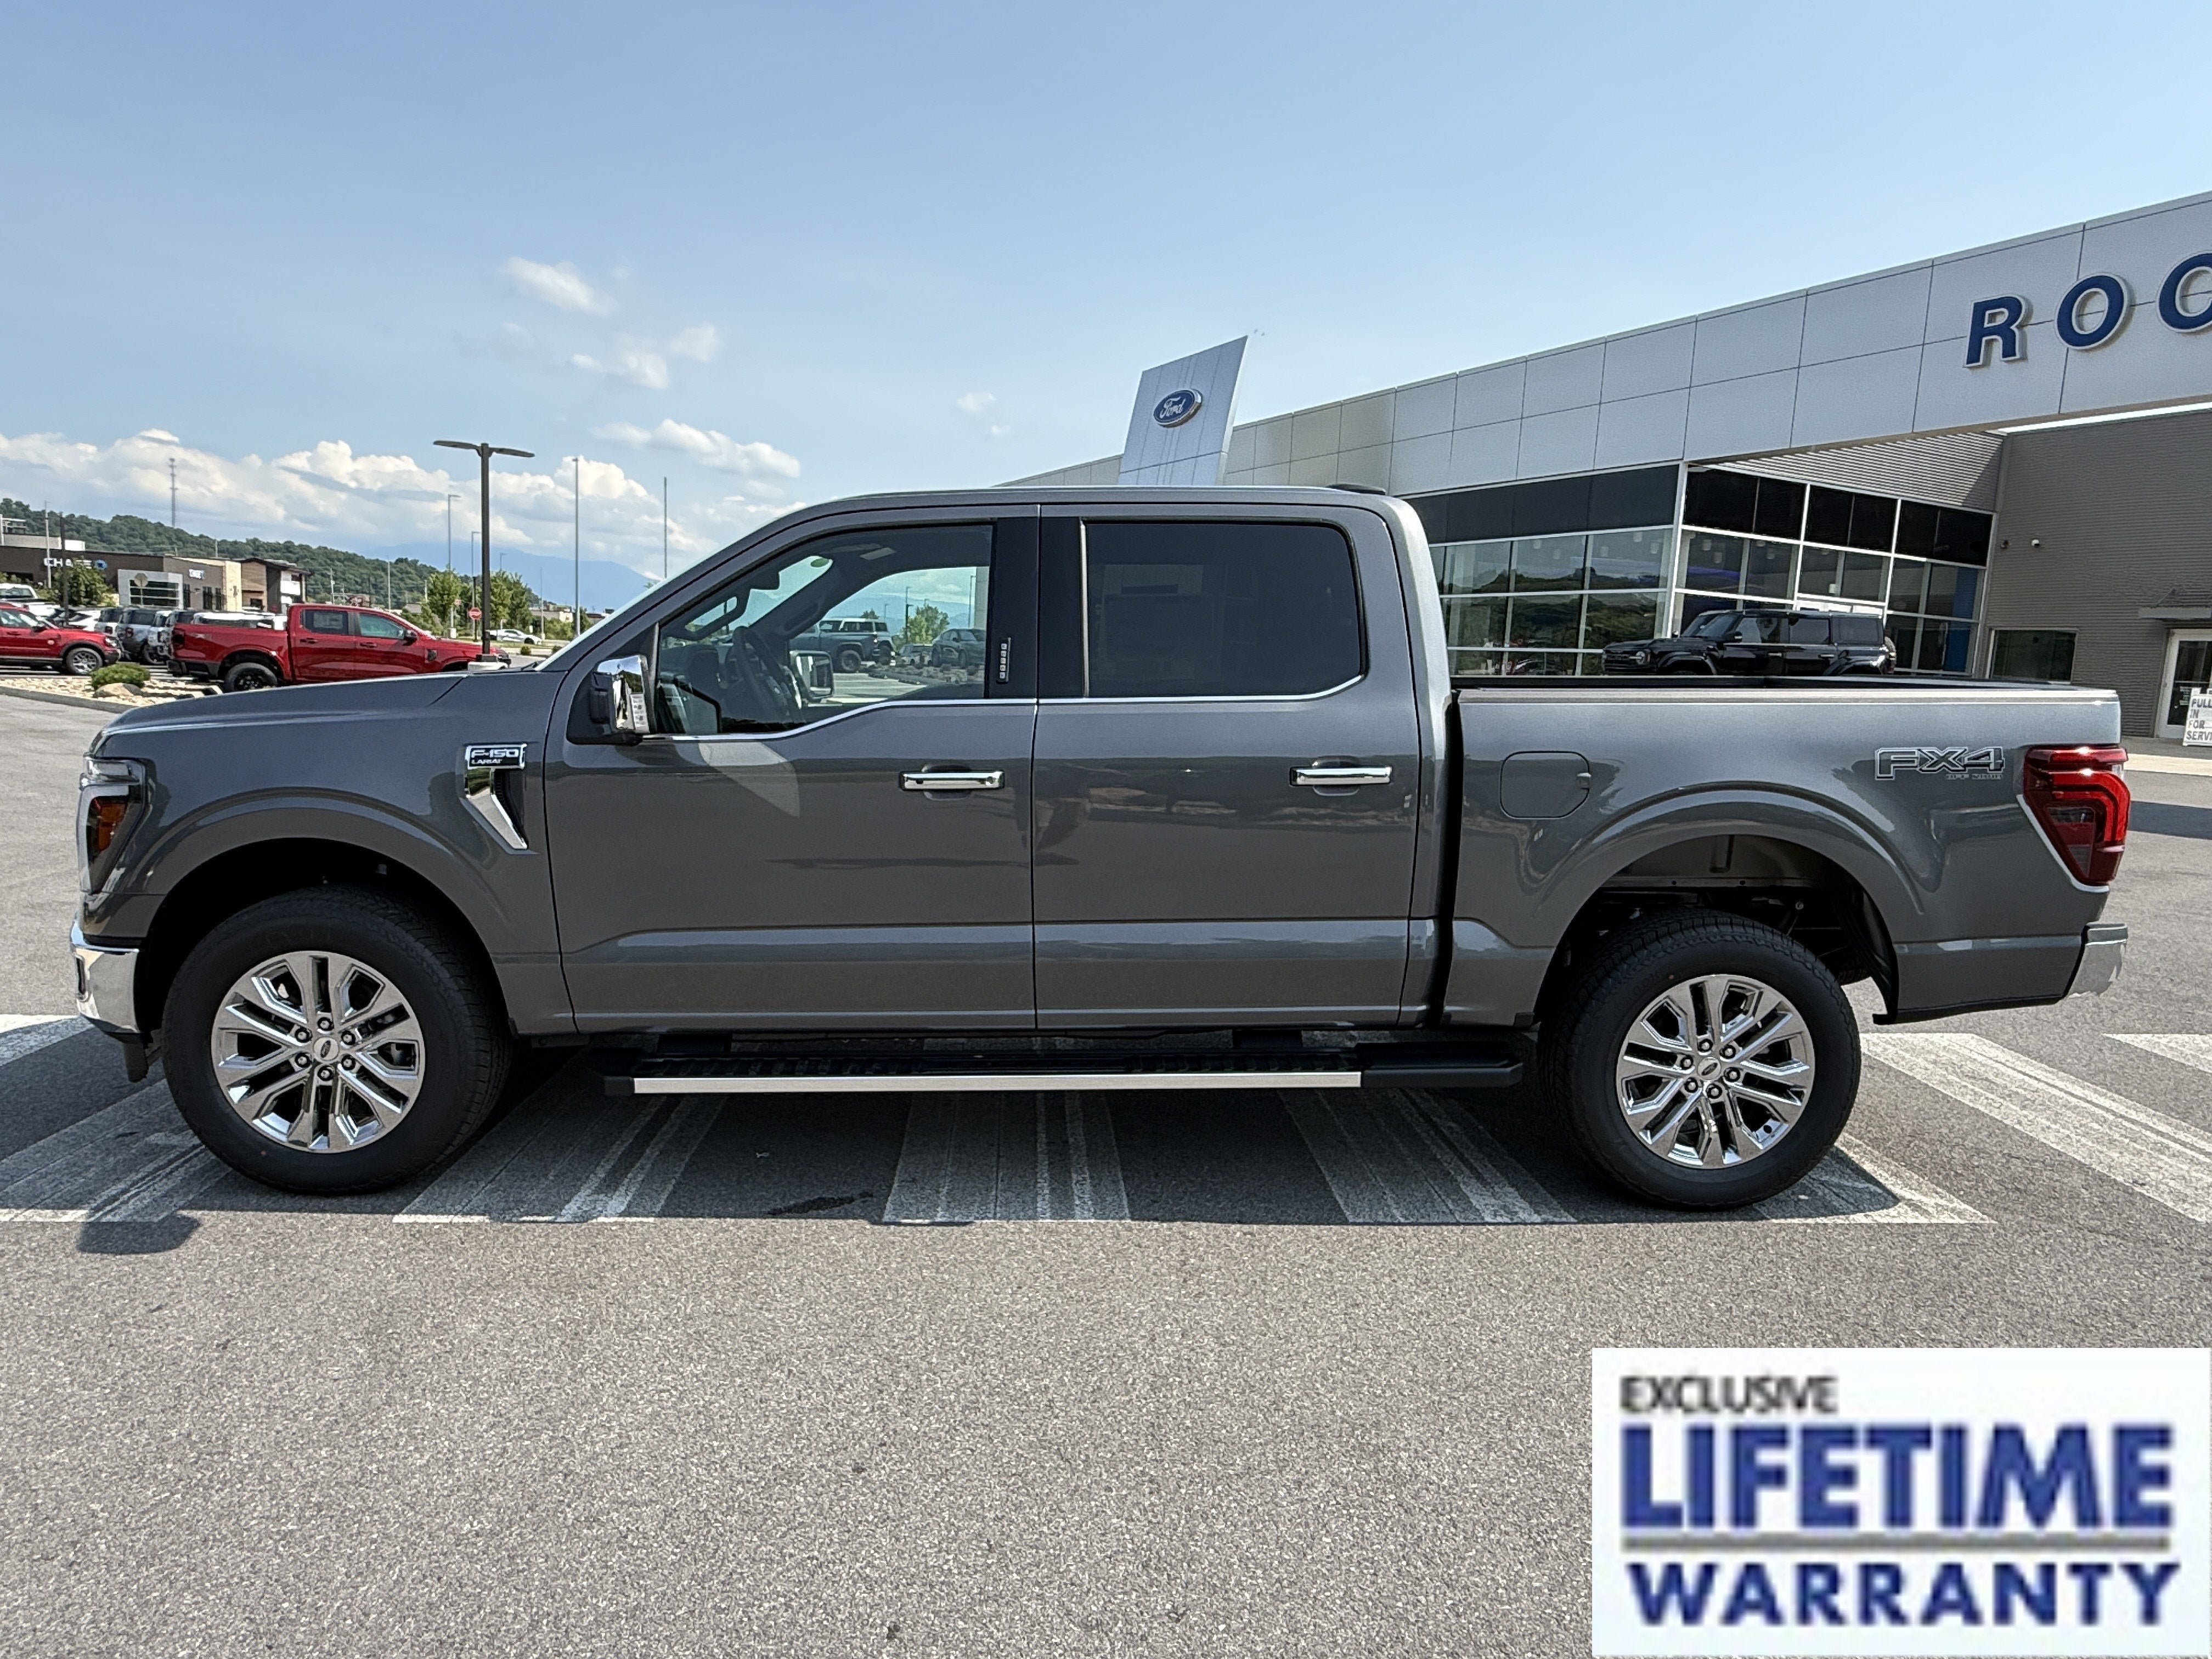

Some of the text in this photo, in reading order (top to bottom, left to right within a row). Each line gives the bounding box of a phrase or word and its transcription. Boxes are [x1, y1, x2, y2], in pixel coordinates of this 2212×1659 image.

[1963, 249, 2212, 368] ROC
[1159, 396, 1186, 419] Ford
[2190, 709, 2199, 719] IN
[2188, 720, 2205, 729] FOR
[471, 748, 519, 758] F-150
[1875, 747, 2005, 780] FX4
